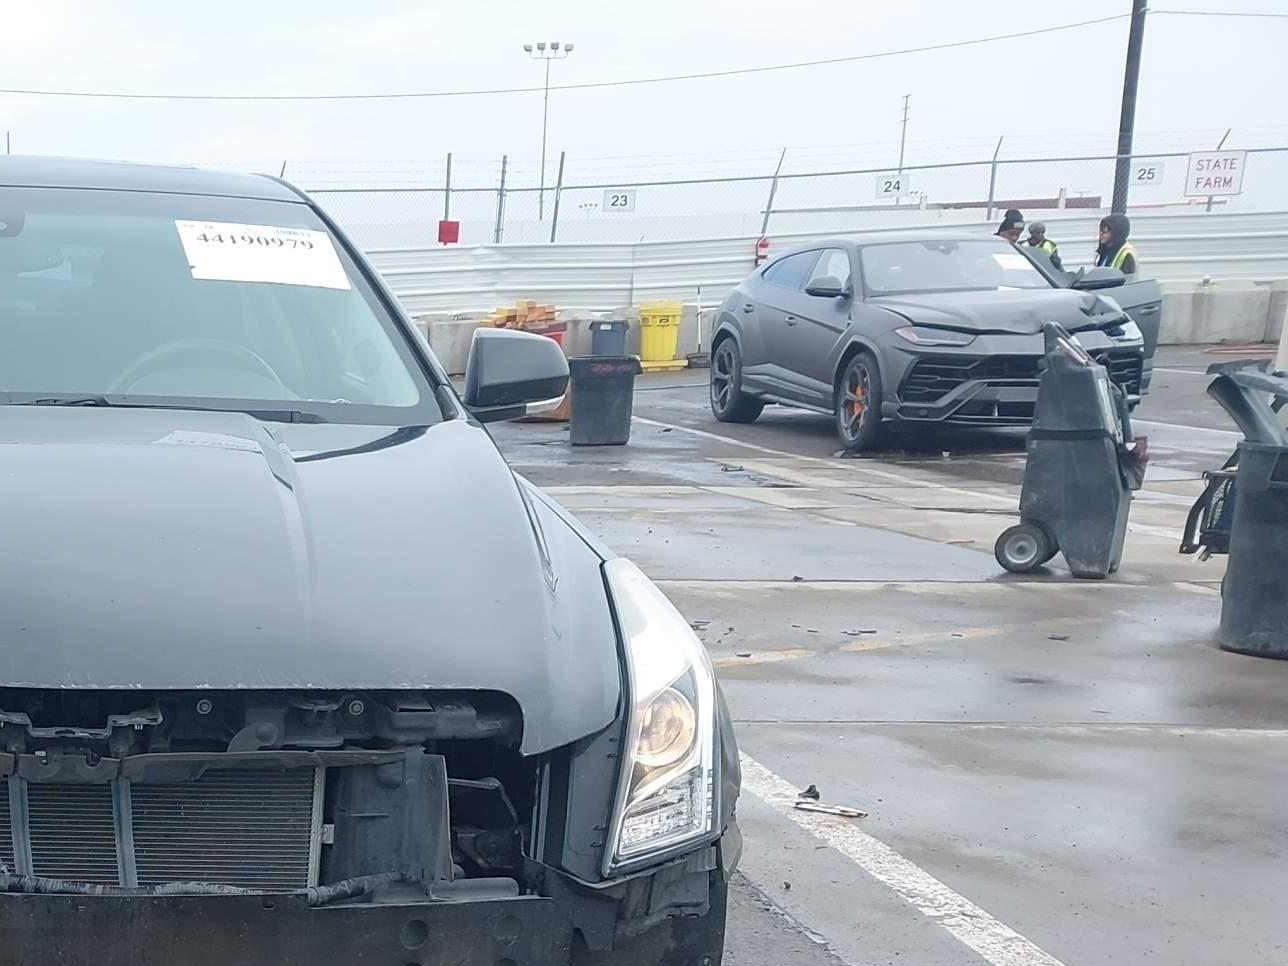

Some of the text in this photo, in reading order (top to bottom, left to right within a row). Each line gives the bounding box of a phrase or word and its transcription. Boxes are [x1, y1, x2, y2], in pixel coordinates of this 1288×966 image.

[1196, 158, 1238, 171] STATE
[1137, 168, 1155, 180] 25
[883, 180, 901, 192] 24
[1195, 177, 1233, 188] FARM
[611, 195, 628, 207] 23
[196, 232, 314, 249] 44190979
